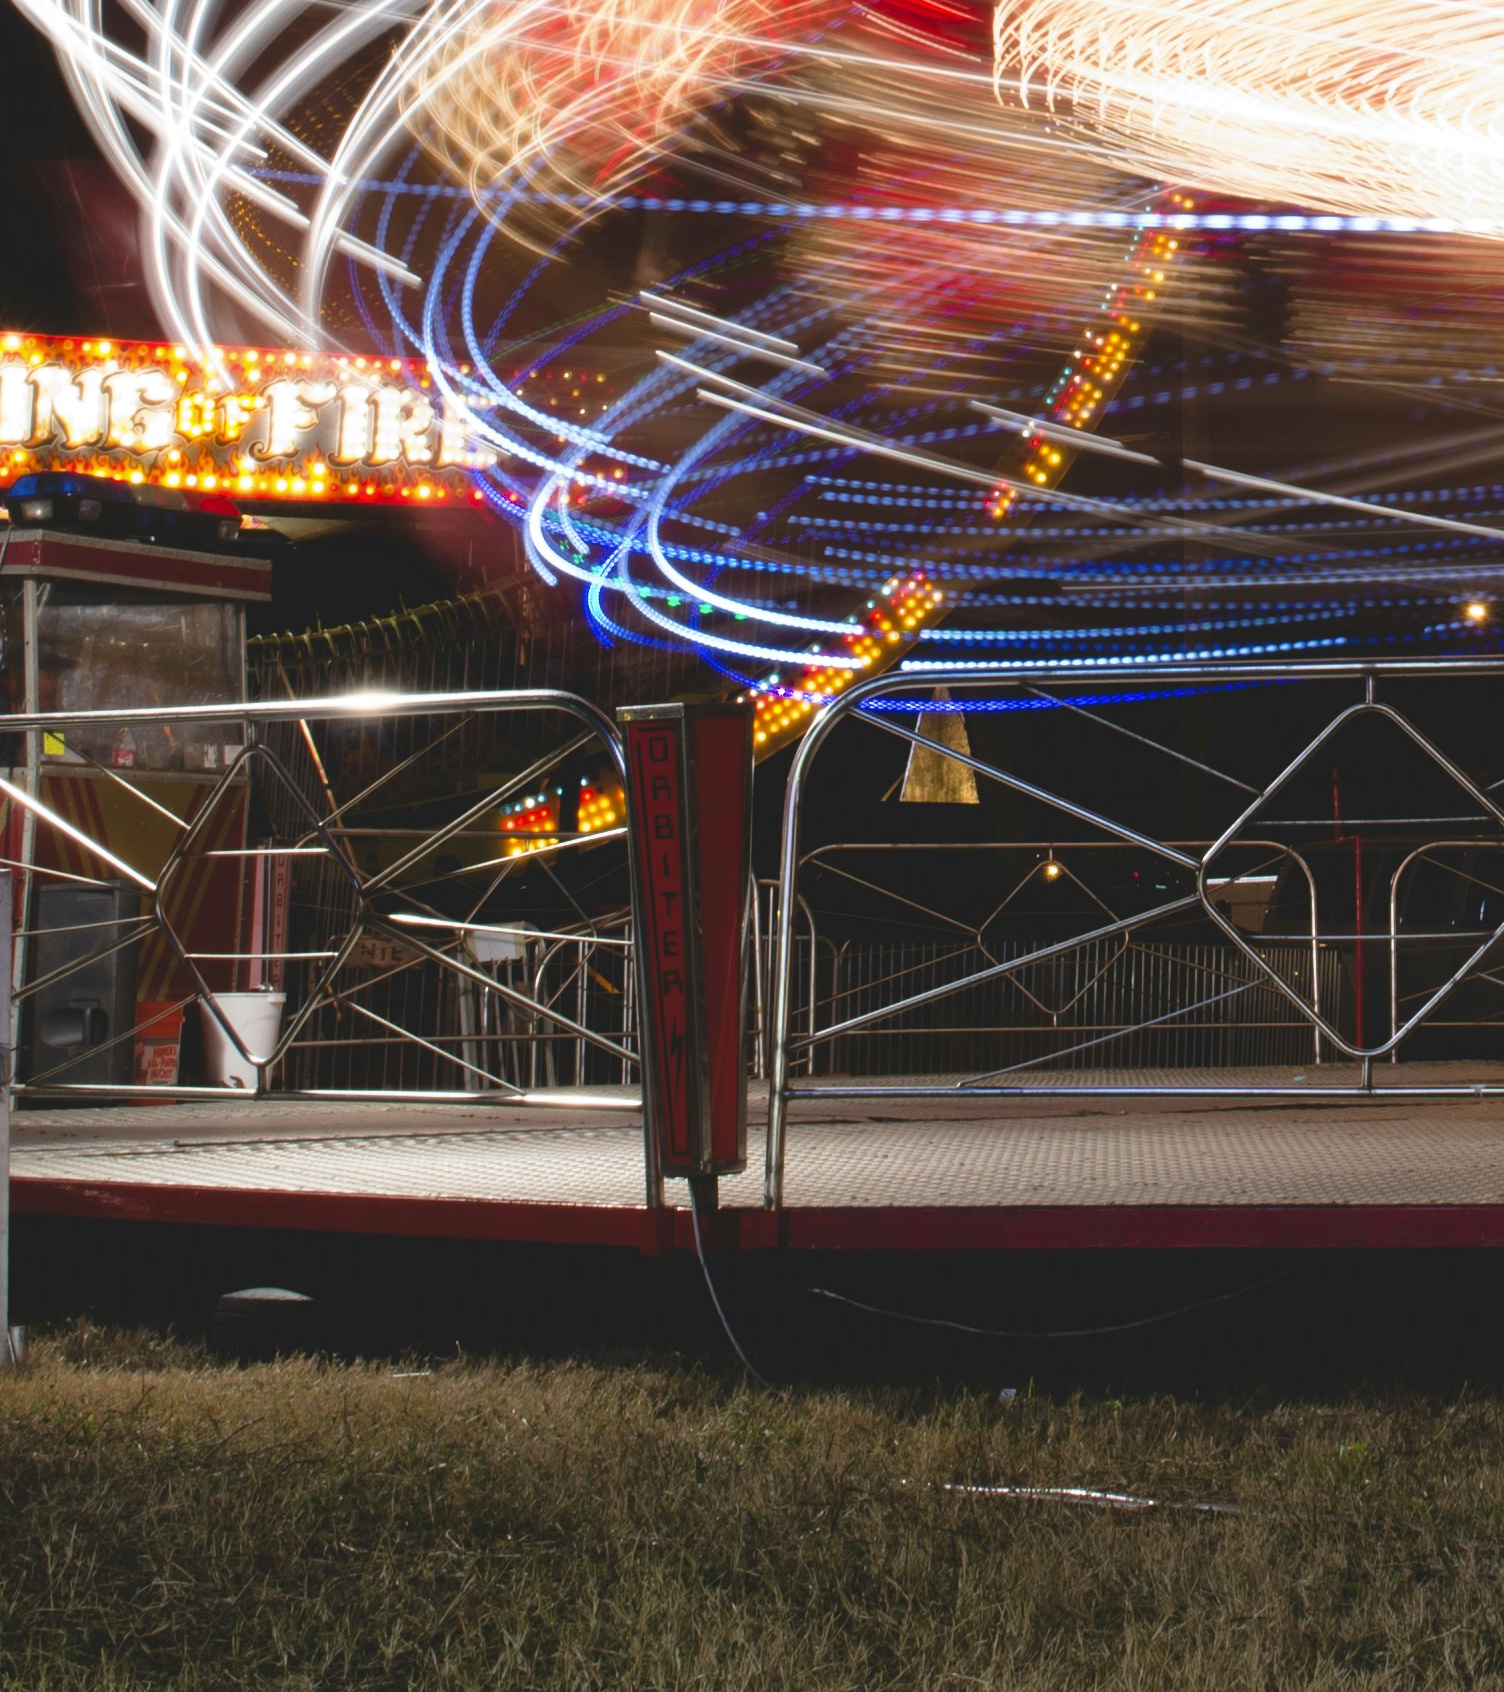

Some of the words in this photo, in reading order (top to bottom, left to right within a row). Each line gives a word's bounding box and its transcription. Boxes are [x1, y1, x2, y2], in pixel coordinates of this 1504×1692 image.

[175, 391, 269, 446] OF
[247, 379, 497, 470] FIRE
[648, 736, 683, 996] ORBITER
